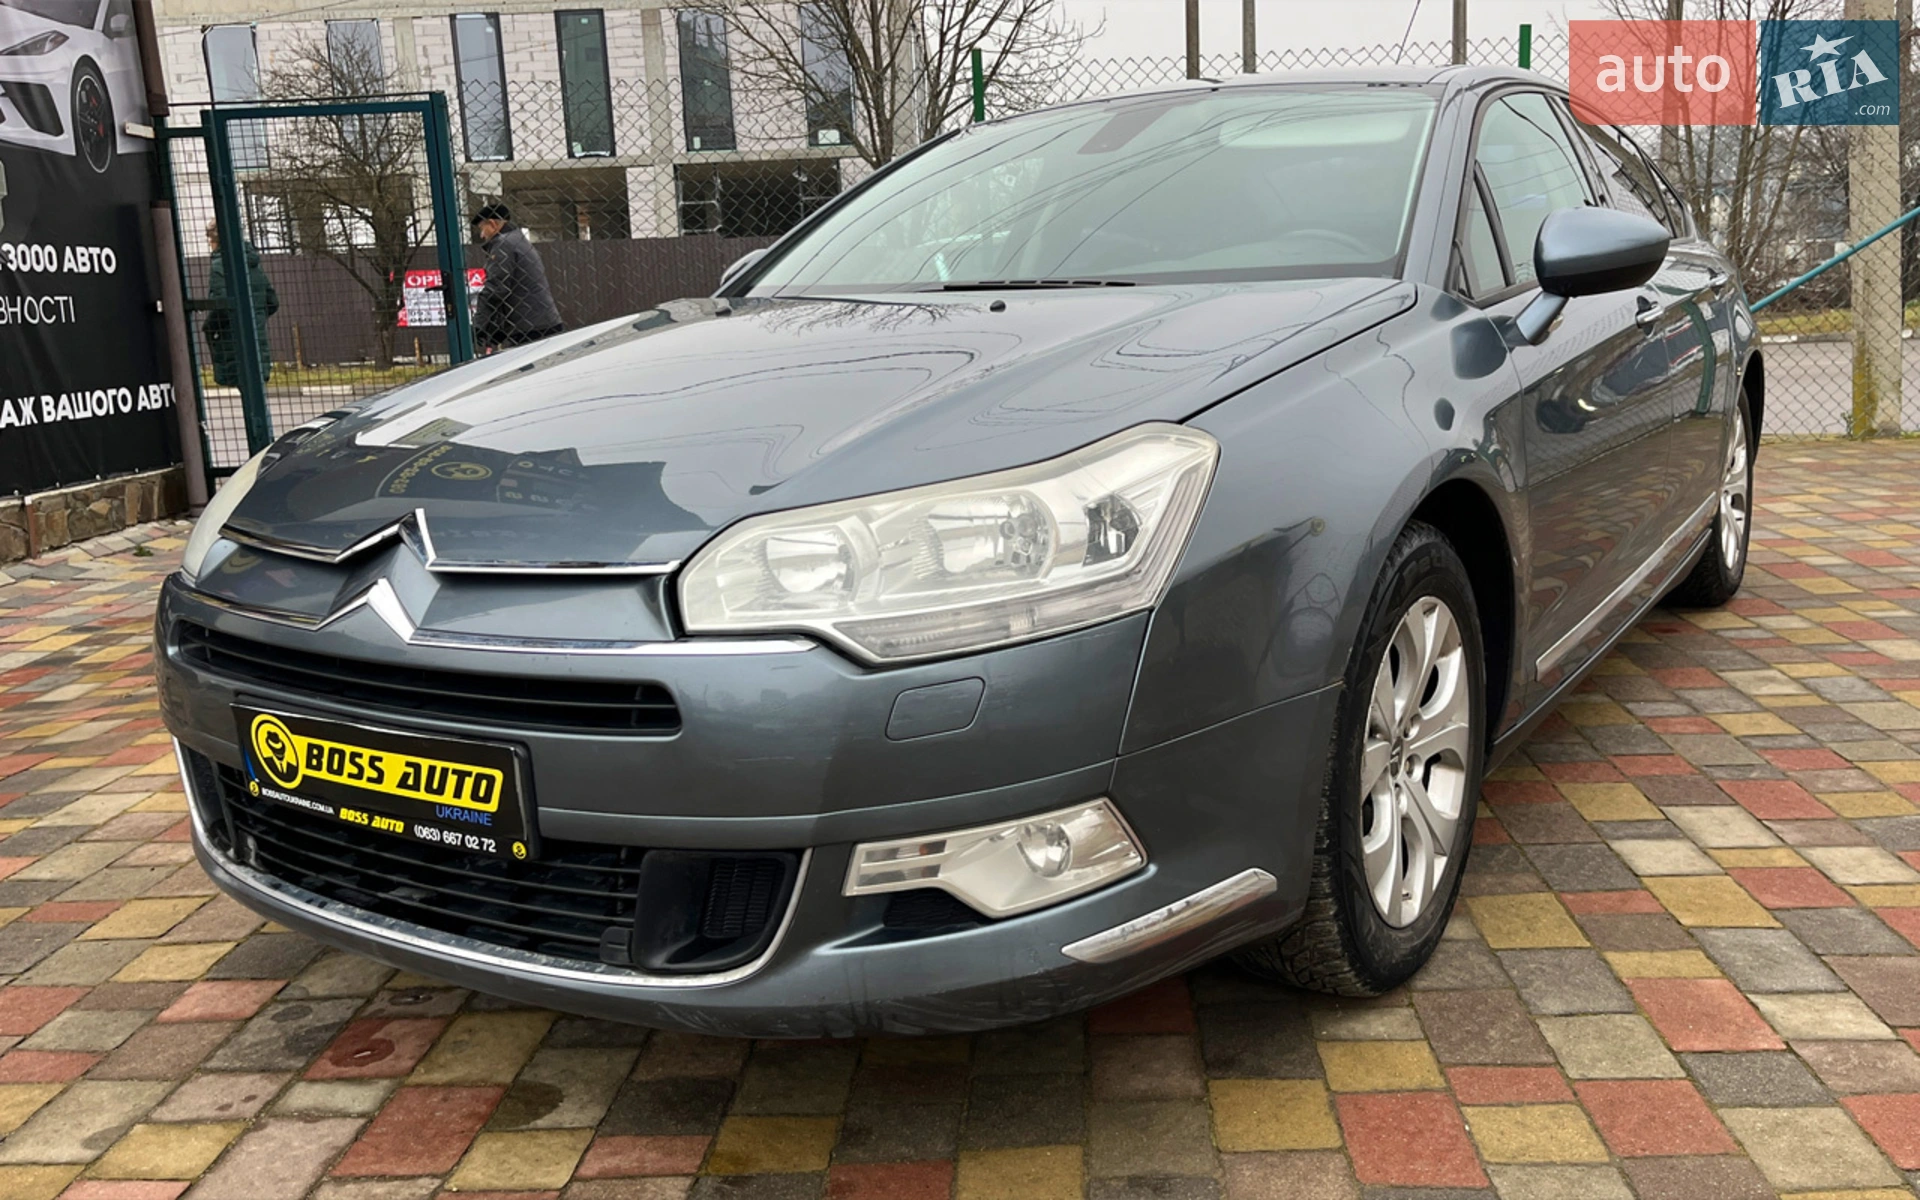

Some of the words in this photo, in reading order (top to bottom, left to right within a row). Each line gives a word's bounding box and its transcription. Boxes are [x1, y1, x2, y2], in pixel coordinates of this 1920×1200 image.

[1, 242, 58, 273] 3000
[62, 245, 117, 274] АВТО
[40, 386, 133, 423] ВАШОГО
[137, 382, 177, 411] АВТ
[305, 742, 386, 784] BOSS
[396, 760, 496, 805] AUTO
[339, 807, 369, 825] BOSS
[371, 815, 405, 833] AUTO
[435, 804, 493, 827] UKRAINE
[413, 824, 441, 842] (063)
[442, 830, 462, 846] 667
[464, 834, 480, 850] 02
[481, 838, 497, 853] 72
